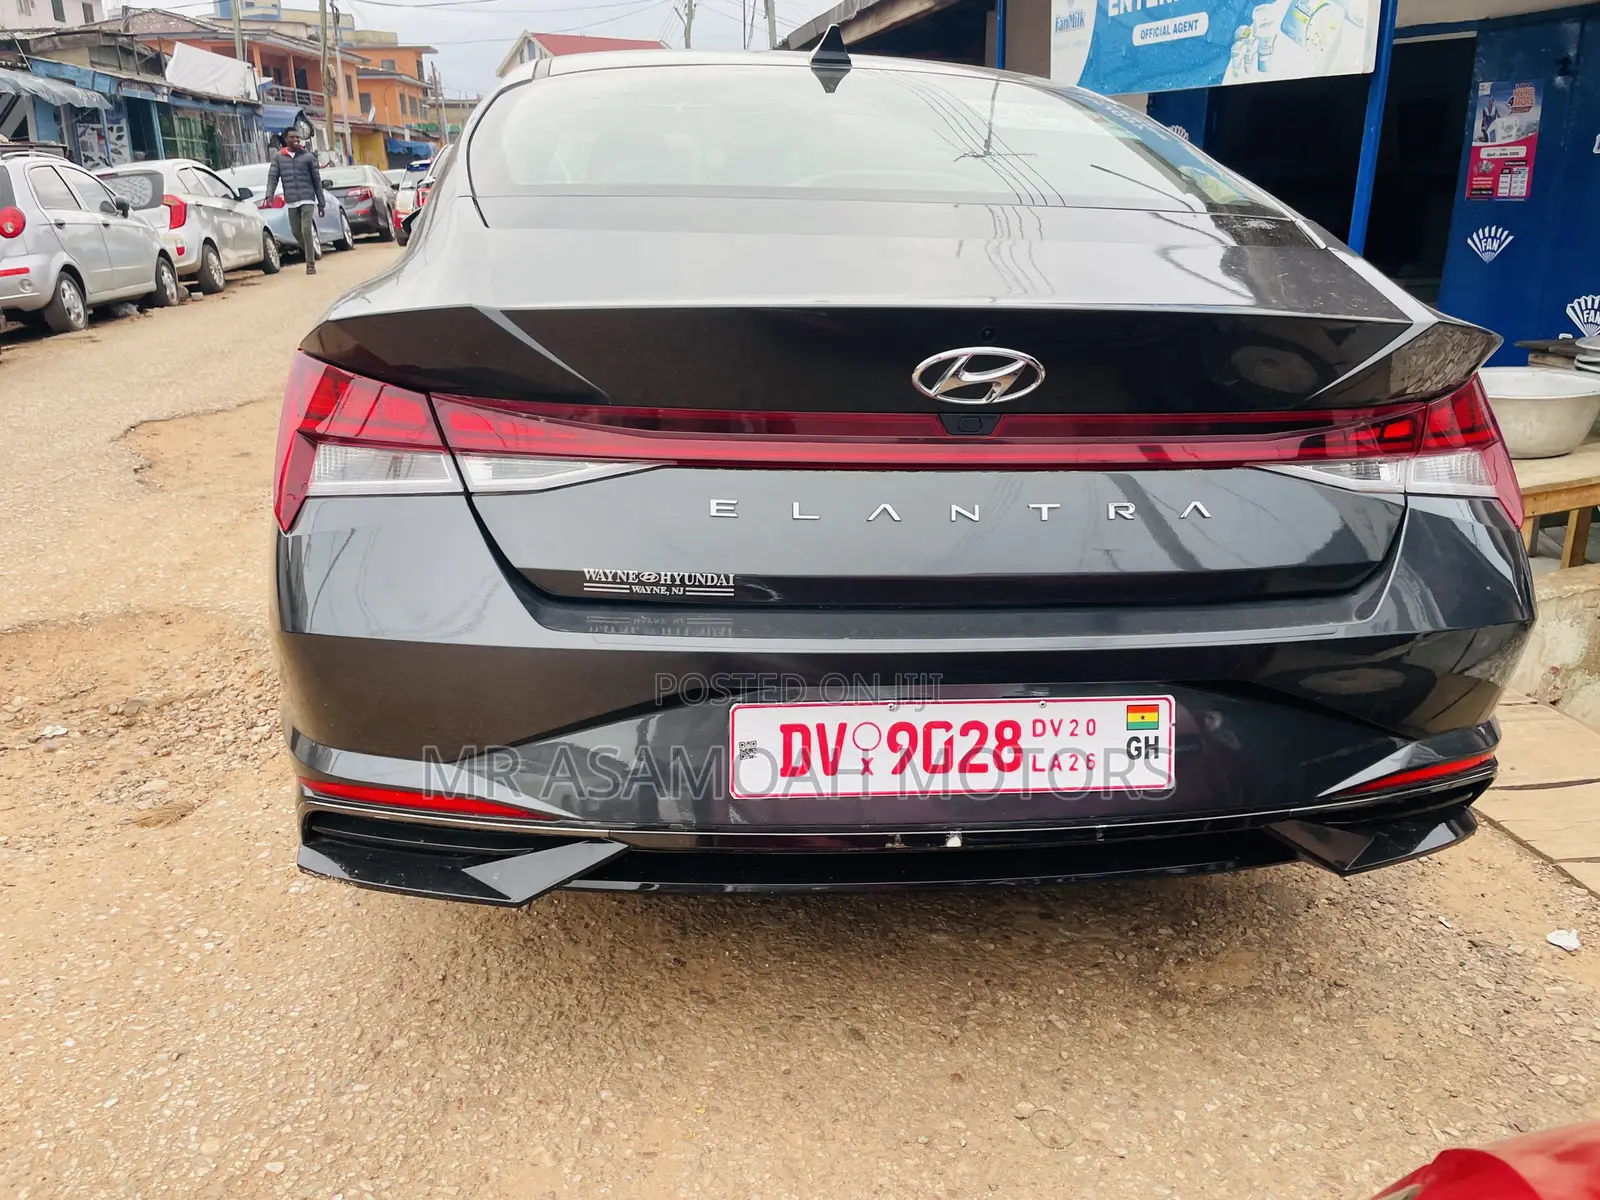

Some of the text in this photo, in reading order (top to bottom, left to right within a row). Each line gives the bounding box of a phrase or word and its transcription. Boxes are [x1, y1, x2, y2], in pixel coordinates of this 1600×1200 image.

[1140, 20, 1199, 40] OFFICIAL AGENT
[1482, 238, 1500, 252] FAN
[709, 498, 1212, 522] ELANTRA
[583, 568, 735, 586] WAYNE HYUNDAI
[631, 585, 685, 596] WAYNE, NJ
[780, 722, 848, 777] DV
[886, 719, 1023, 775] 9028
[1126, 736, 1159, 760] GH
